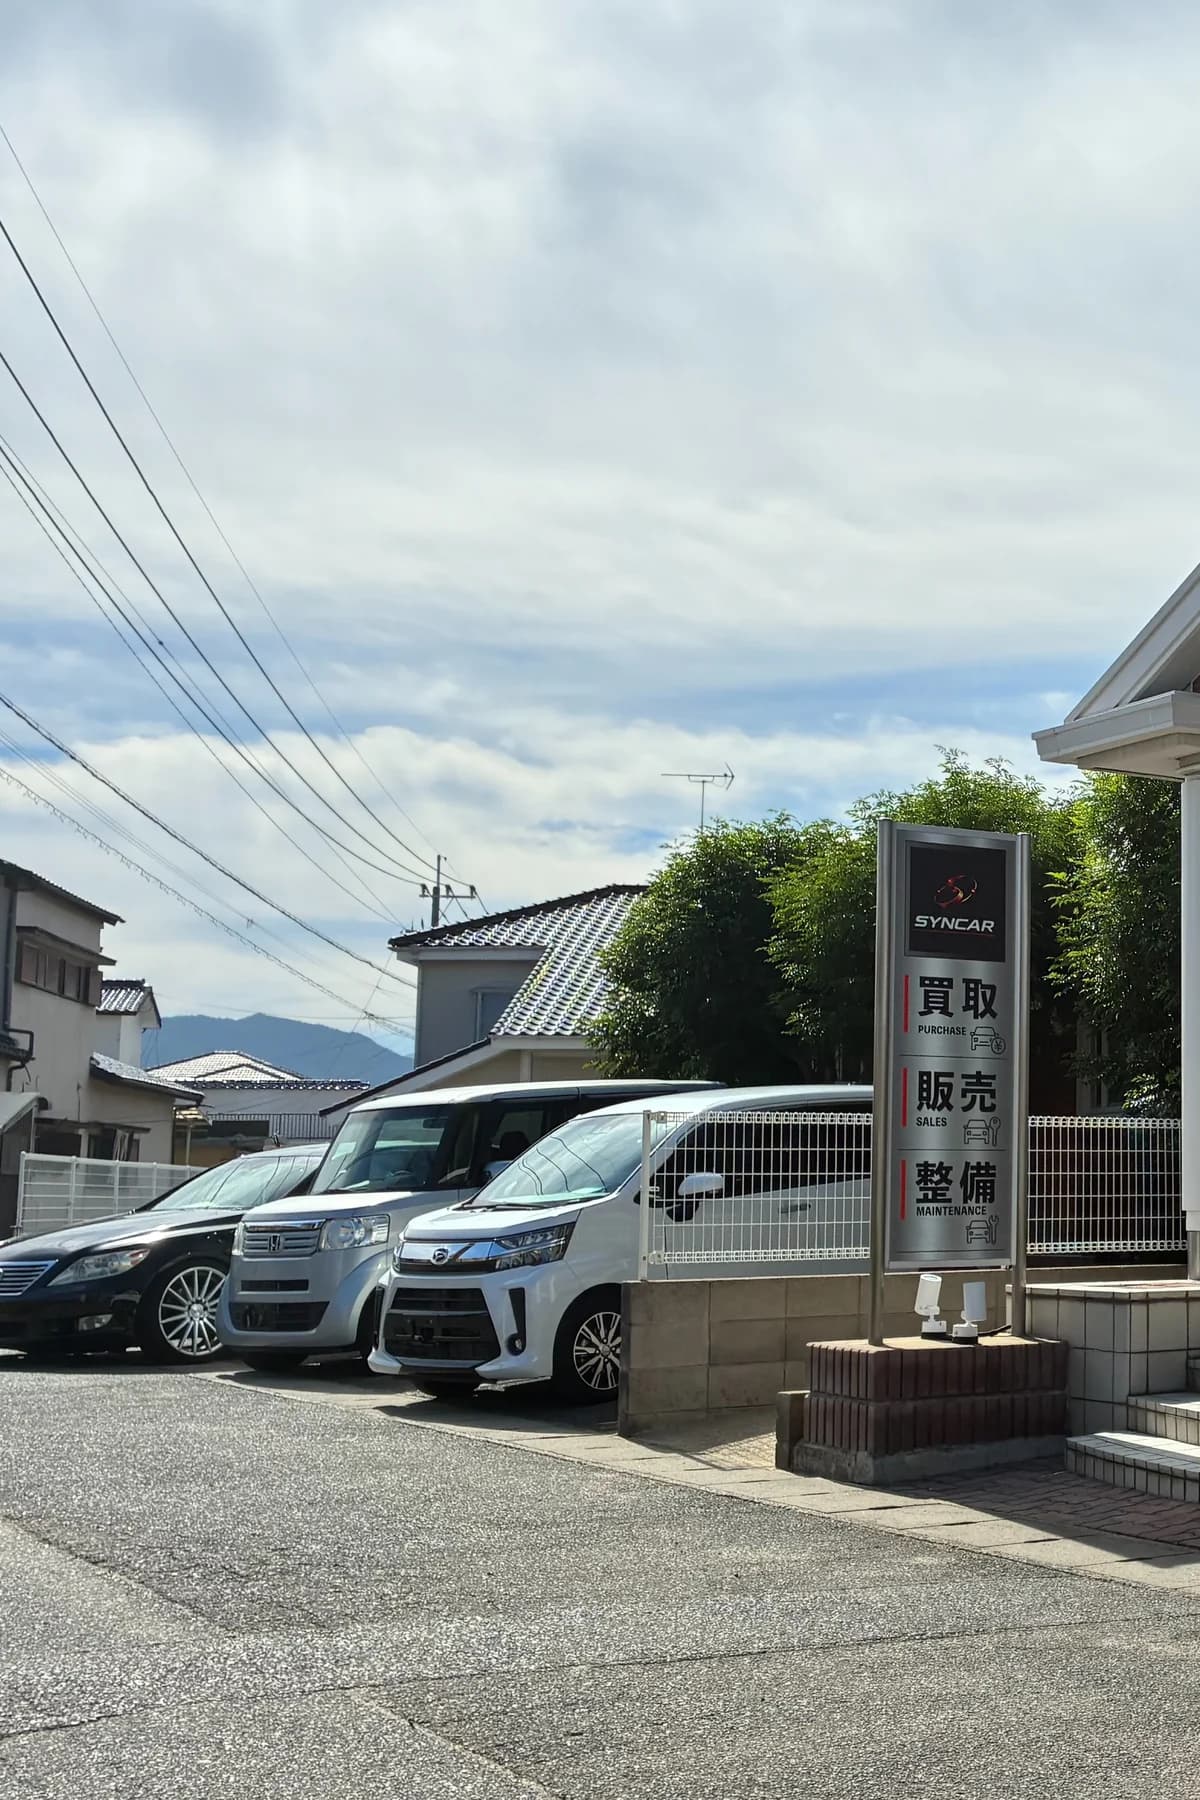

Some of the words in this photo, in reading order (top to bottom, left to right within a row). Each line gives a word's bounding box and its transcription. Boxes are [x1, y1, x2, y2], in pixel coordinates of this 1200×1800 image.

[914, 915, 995, 933] SYNCAR
[918, 976, 998, 1020] 買取
[918, 1024, 967, 1036] PURCHASE
[916, 1070, 997, 1113] 販売
[916, 1117, 948, 1127] SALES
[915, 1161, 997, 1204] 整備
[916, 1206, 988, 1217] MAINTENANCE
